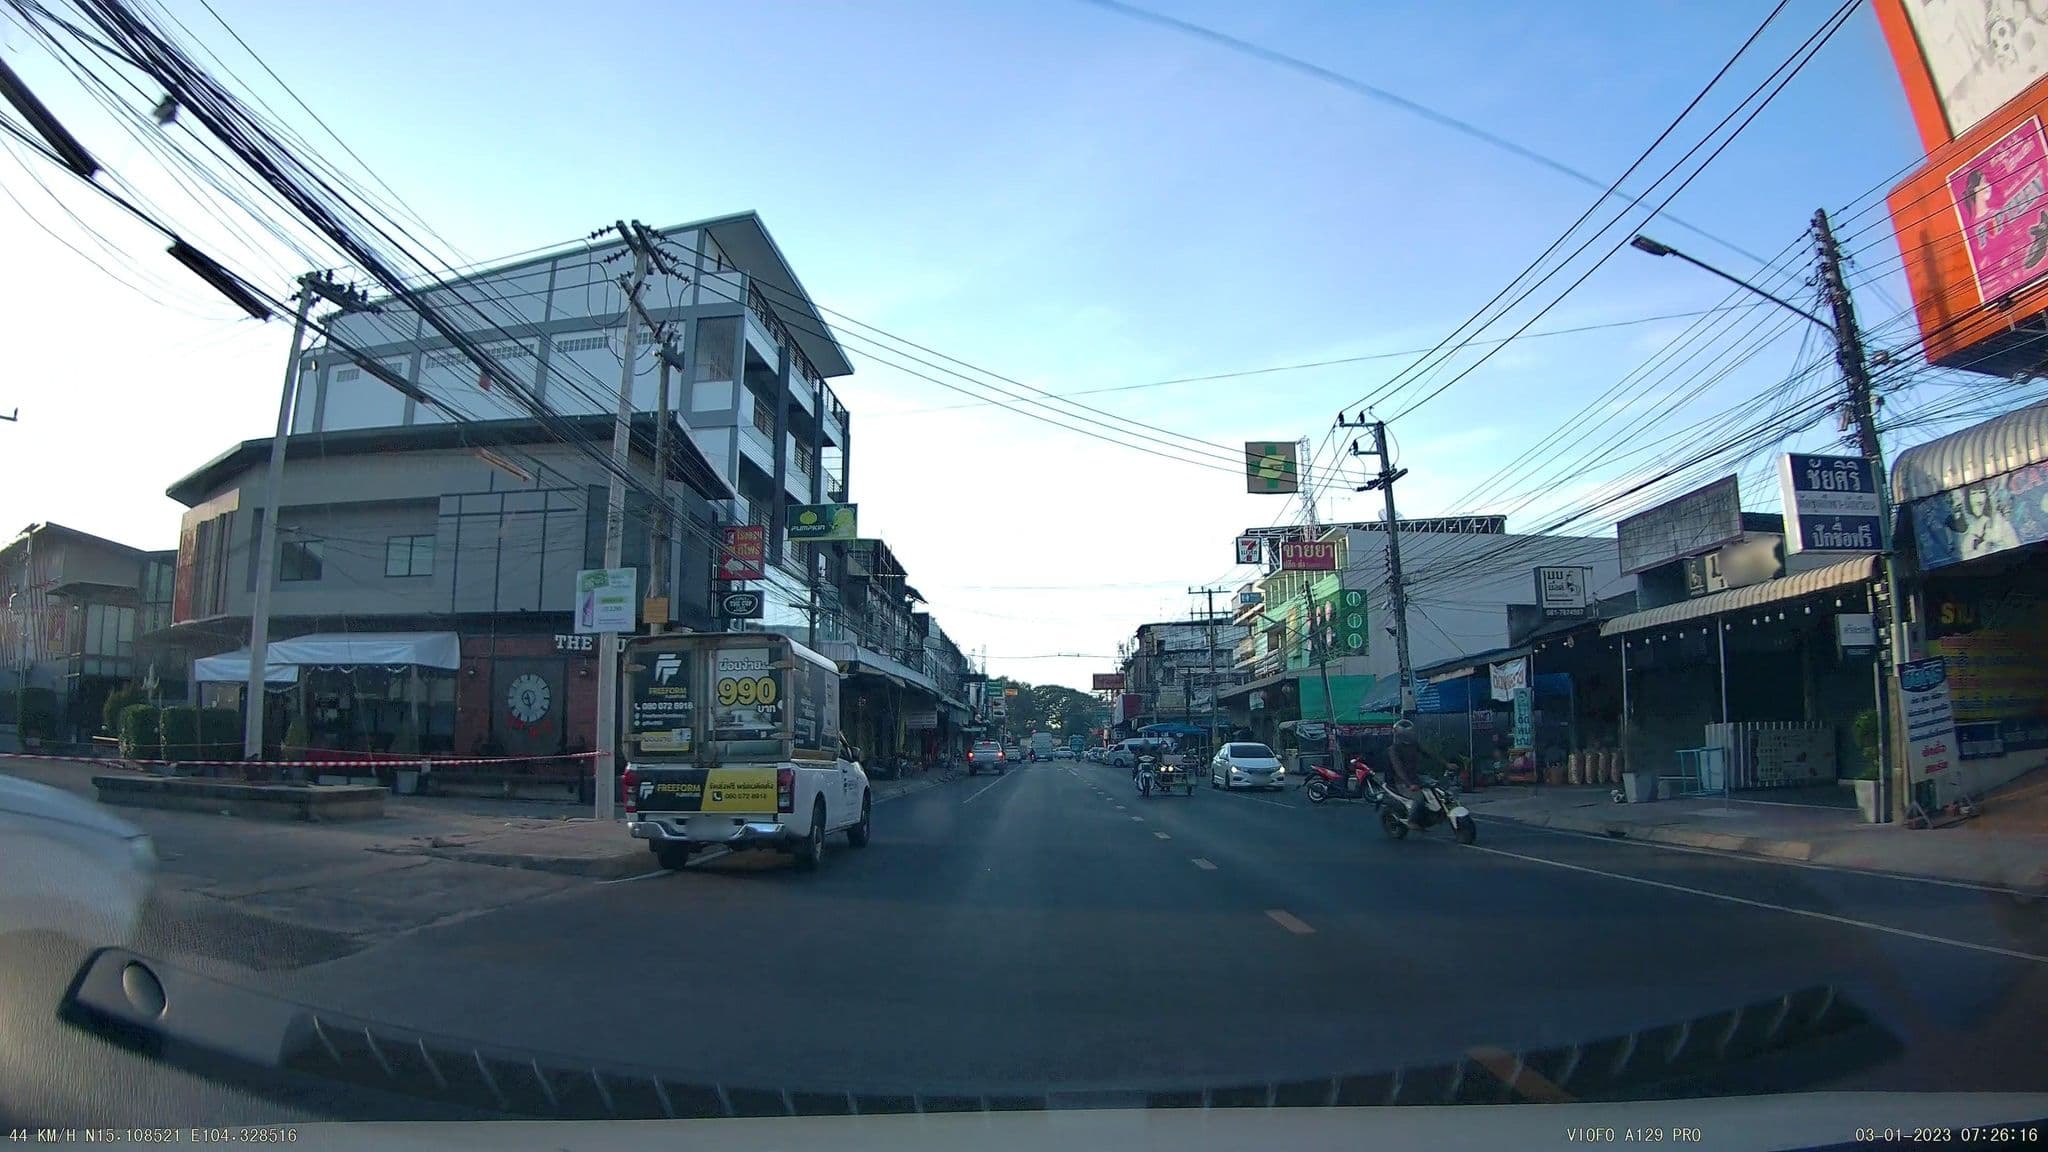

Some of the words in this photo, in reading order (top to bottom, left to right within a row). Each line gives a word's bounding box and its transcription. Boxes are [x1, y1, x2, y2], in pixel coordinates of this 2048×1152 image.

[1806, 458, 1861, 491] ชัยศิริ
[1811, 516, 1873, 547] ปักชื่อฟรี
[1284, 544, 1334, 558] ขายยา
[555, 634, 593, 650] THE
[718, 676, 777, 706] 990
[657, 783, 701, 792] FREEFORM
